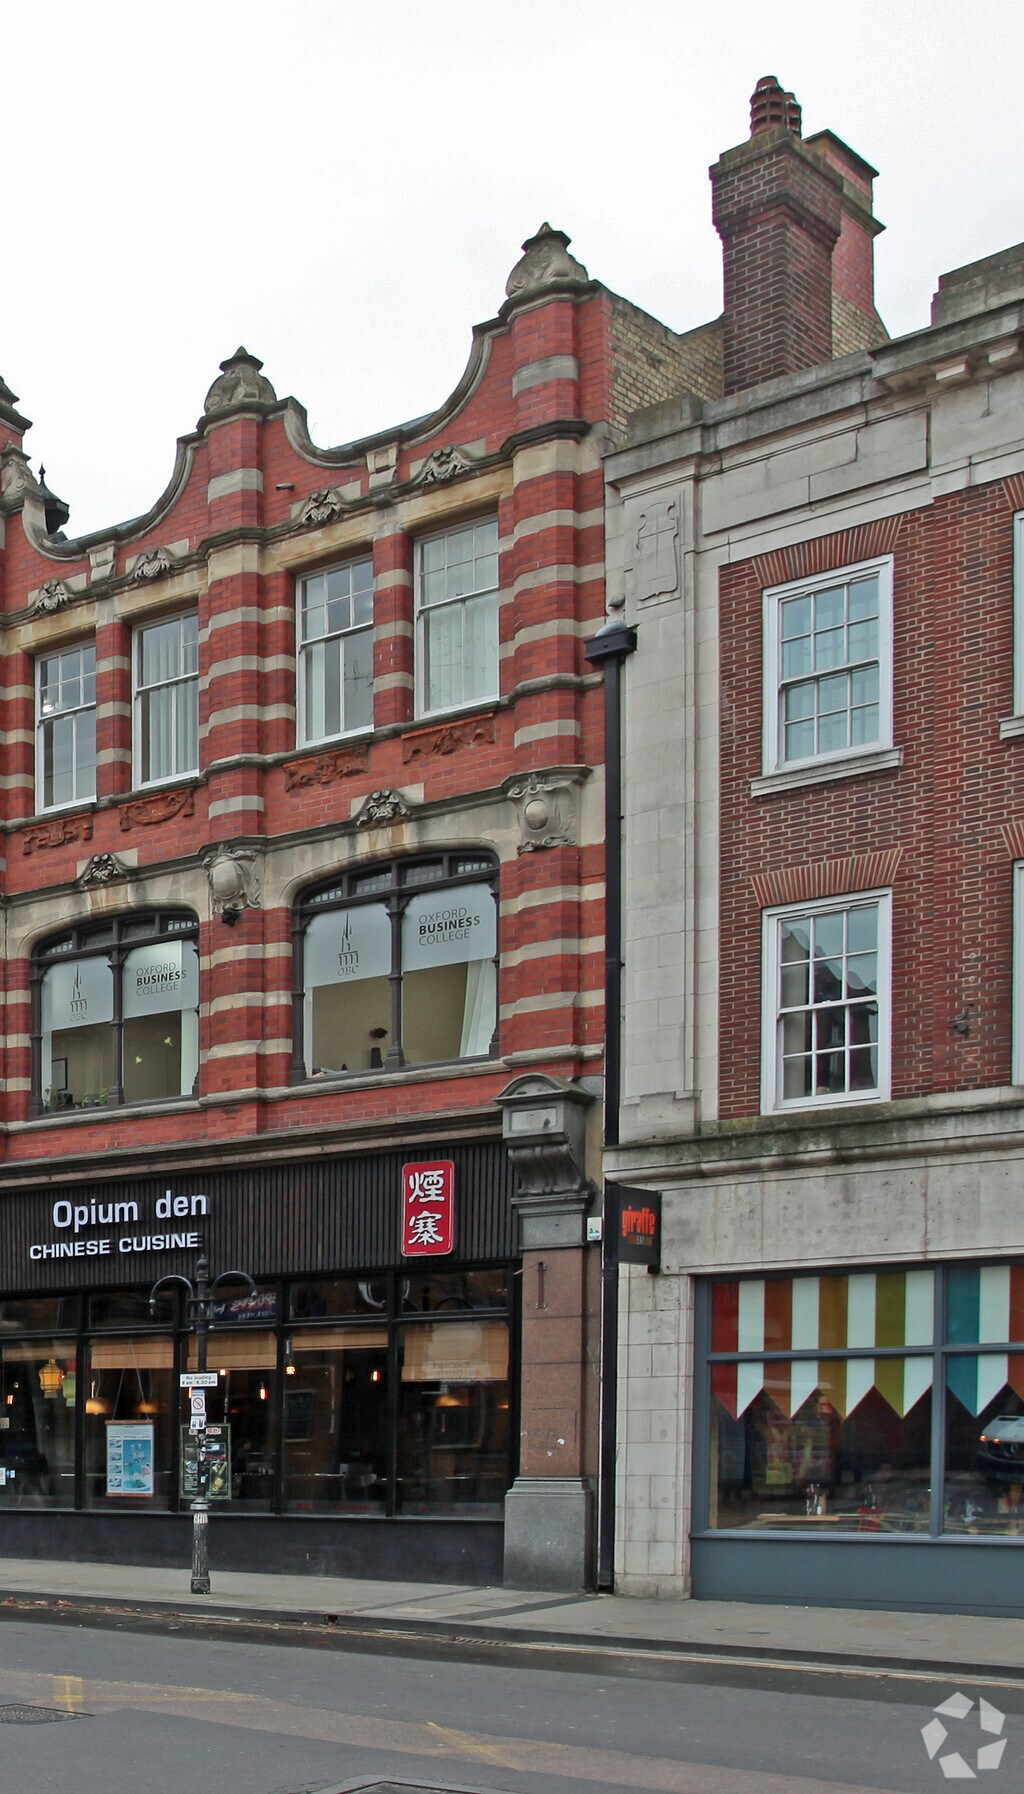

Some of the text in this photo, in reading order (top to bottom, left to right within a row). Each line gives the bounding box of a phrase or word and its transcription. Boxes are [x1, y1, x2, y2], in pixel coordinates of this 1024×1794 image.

[418, 907, 467, 925] OXFORD
[419, 915, 480, 936] BUSINESS
[418, 928, 470, 947] COLLEGE
[136, 962, 177, 977] OXFORD
[136, 969, 187, 987] BUSINESS
[337, 965, 359, 977] OBC
[136, 981, 178, 997] COLLEGE
[53, 1190, 207, 1233] Opium den
[622, 1205, 656, 1237] giraffe
[29, 1232, 199, 1260] CHINESE CUISINE
